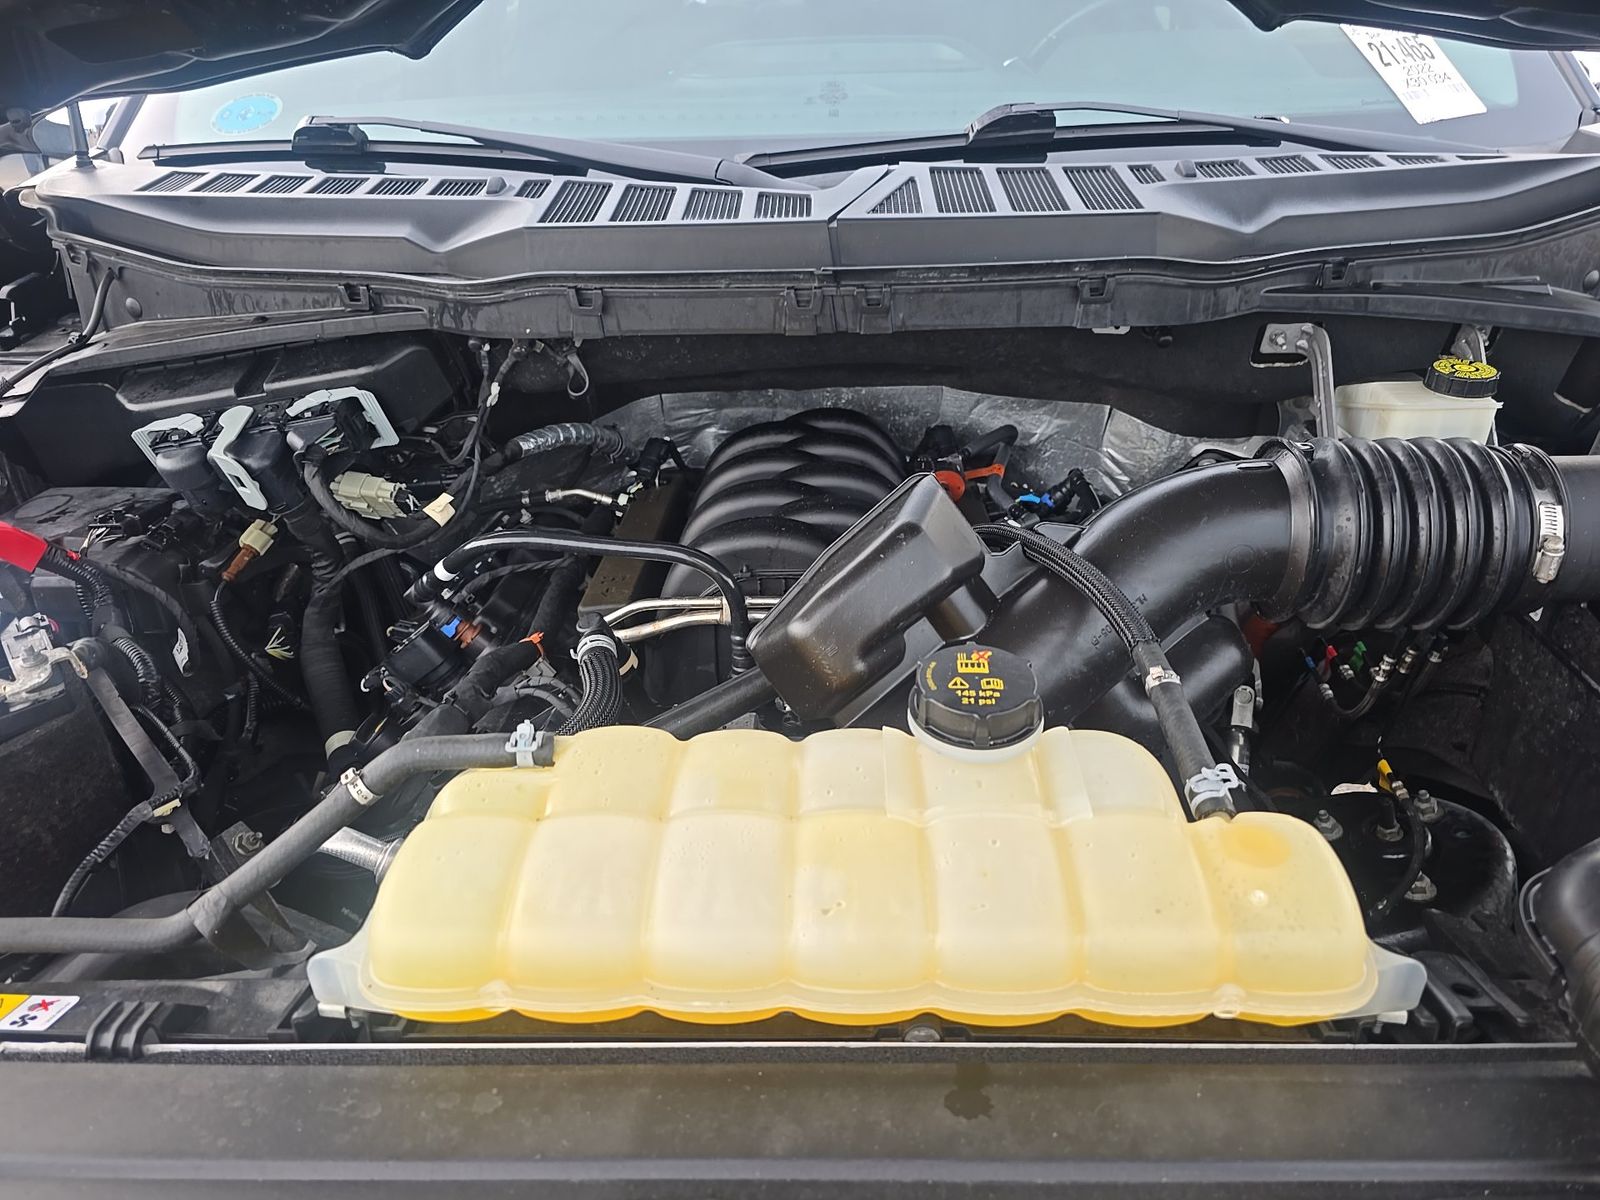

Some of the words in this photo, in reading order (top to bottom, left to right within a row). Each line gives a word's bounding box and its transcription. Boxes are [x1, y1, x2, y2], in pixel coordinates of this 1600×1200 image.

[955, 689, 977, 698] 145
[978, 689, 1001, 698] kPa
[961, 697, 975, 705] 21
[978, 697, 996, 706] psi
